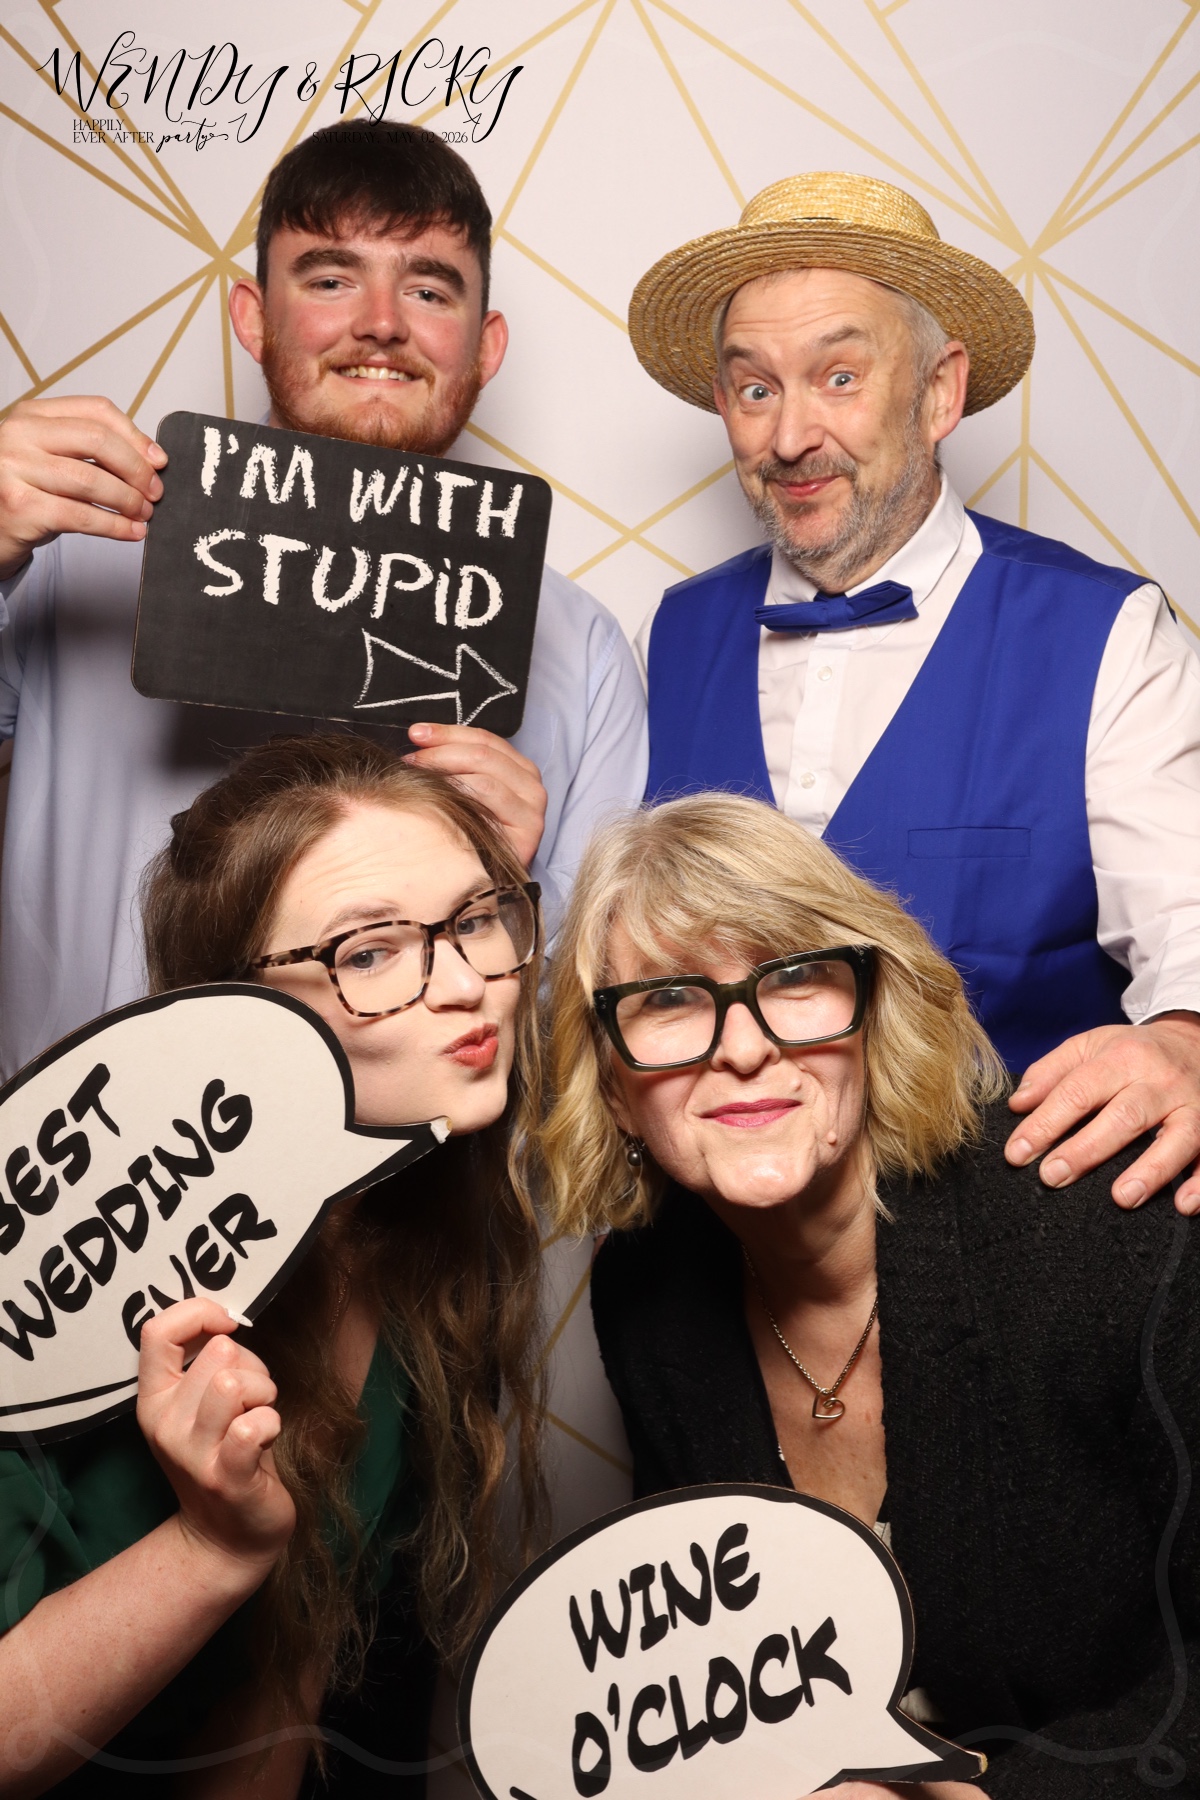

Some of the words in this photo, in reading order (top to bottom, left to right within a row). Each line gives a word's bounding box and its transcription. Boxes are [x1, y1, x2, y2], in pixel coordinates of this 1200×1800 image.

[201, 426, 316, 509] I'M
[0, 1079, 252, 1361] WEDDING
[121, 1193, 278, 1353] EVER
[569, 1522, 761, 1673] WINE
[571, 1616, 853, 1798] O'CLOCK
